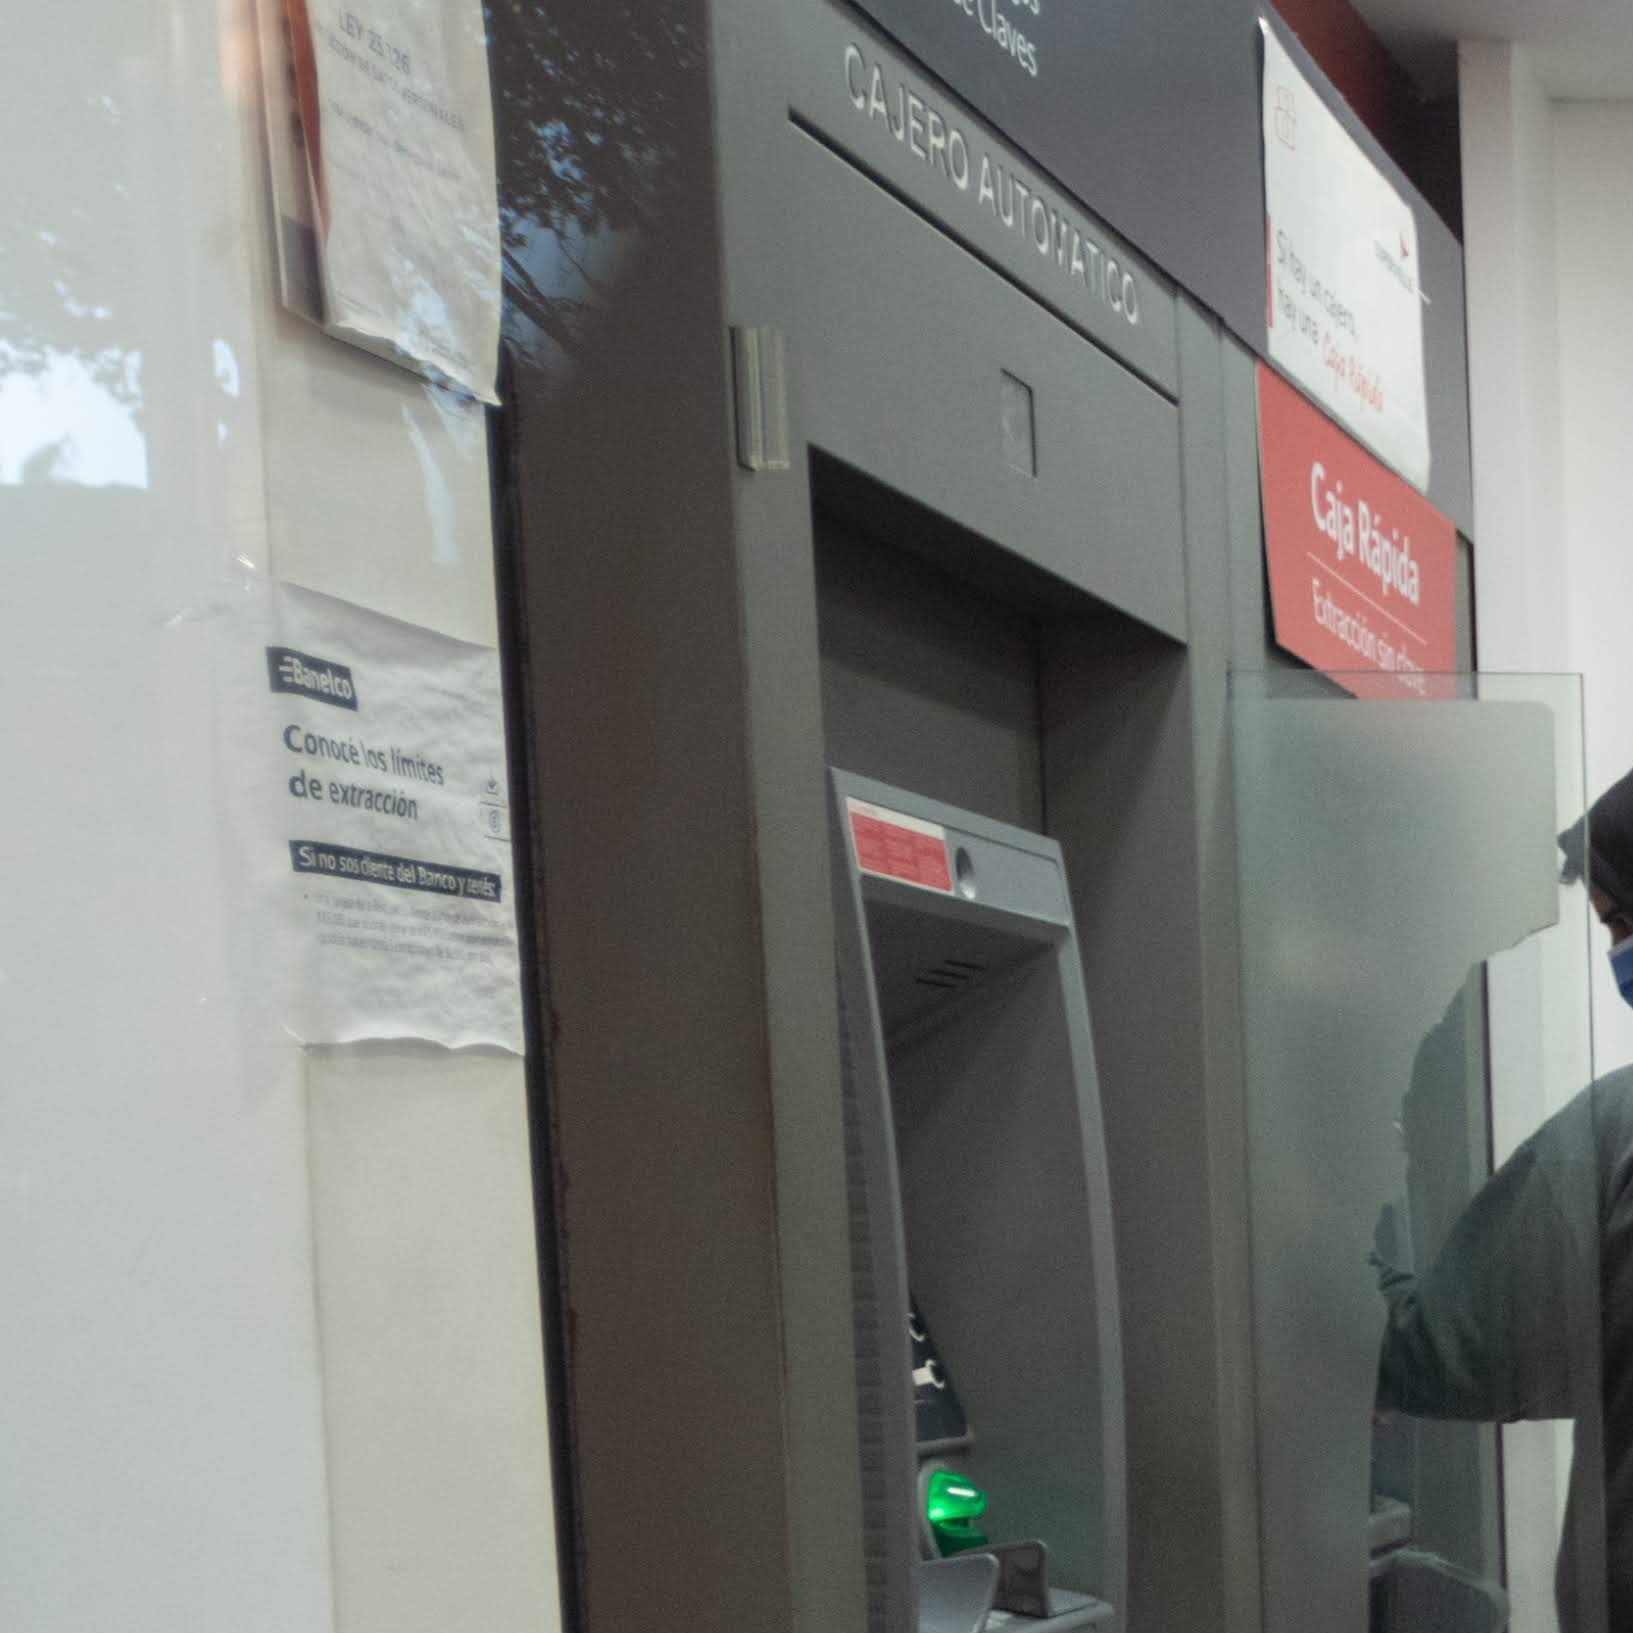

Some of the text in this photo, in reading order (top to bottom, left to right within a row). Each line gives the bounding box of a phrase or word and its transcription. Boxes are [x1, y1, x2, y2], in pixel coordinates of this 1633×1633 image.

[844, 43, 1139, 327] CAJERO AUTOMATICO
[1311, 461, 1421, 606] Caja Rápida
[290, 656, 352, 700] Banelco
[283, 724, 361, 766] Conoce
[363, 741, 388, 773] los
[288, 769, 418, 821] de extracción
[299, 845, 314, 867] Si
[319, 854, 336, 871] no
[339, 855, 360, 875] sos
[396, 863, 417, 883] del
[418, 867, 455, 890] Banco
